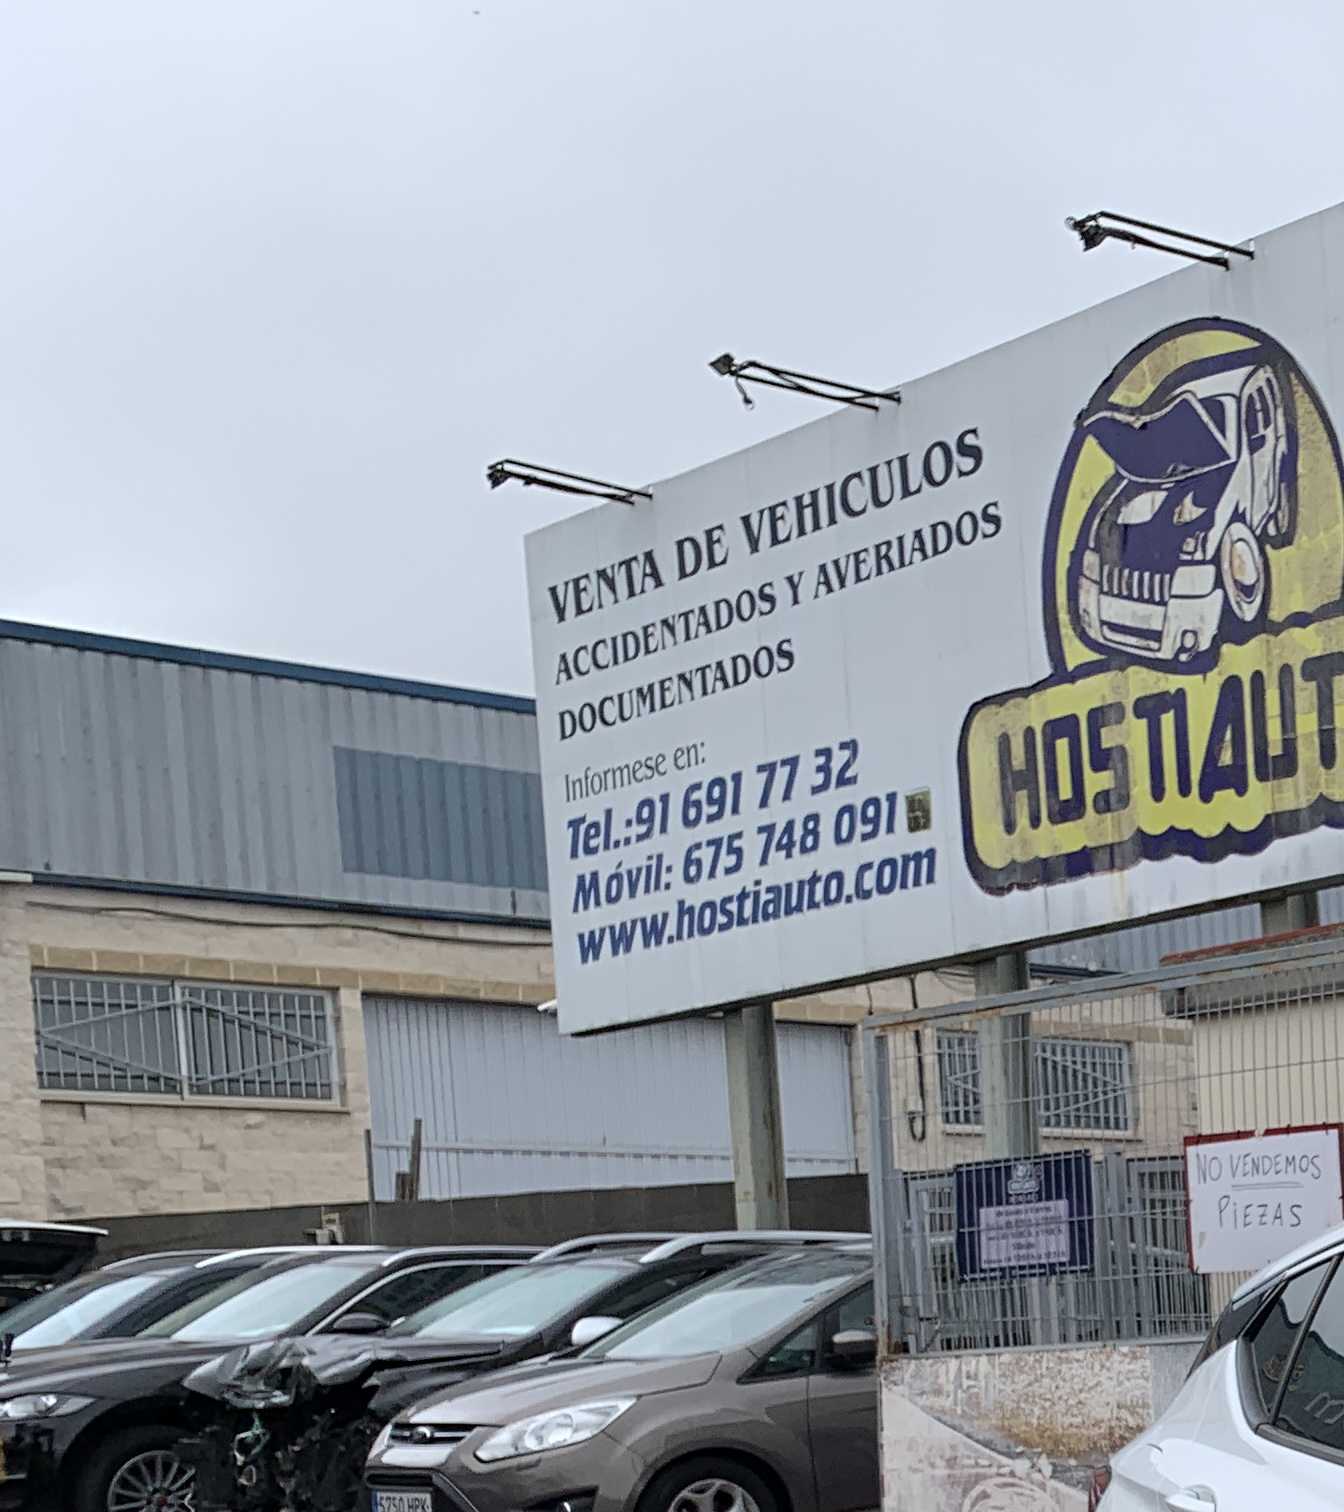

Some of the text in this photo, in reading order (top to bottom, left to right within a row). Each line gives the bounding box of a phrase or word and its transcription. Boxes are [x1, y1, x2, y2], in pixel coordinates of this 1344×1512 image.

[548, 427, 984, 624] VENTA DE VEHICULOS
[555, 501, 1002, 685] ACCIDENTADOS Y AVERIADOS
[559, 638, 795, 741] DOCUMENTADOS
[565, 741, 706, 803] Informese en:
[567, 738, 858, 860] Tel.:91 691 77 32
[572, 791, 897, 914] Móvil: 675 748 091
[577, 847, 937, 965] www.hostiauto.com
[1196, 1152, 1321, 1184] NO VENDEMOS
